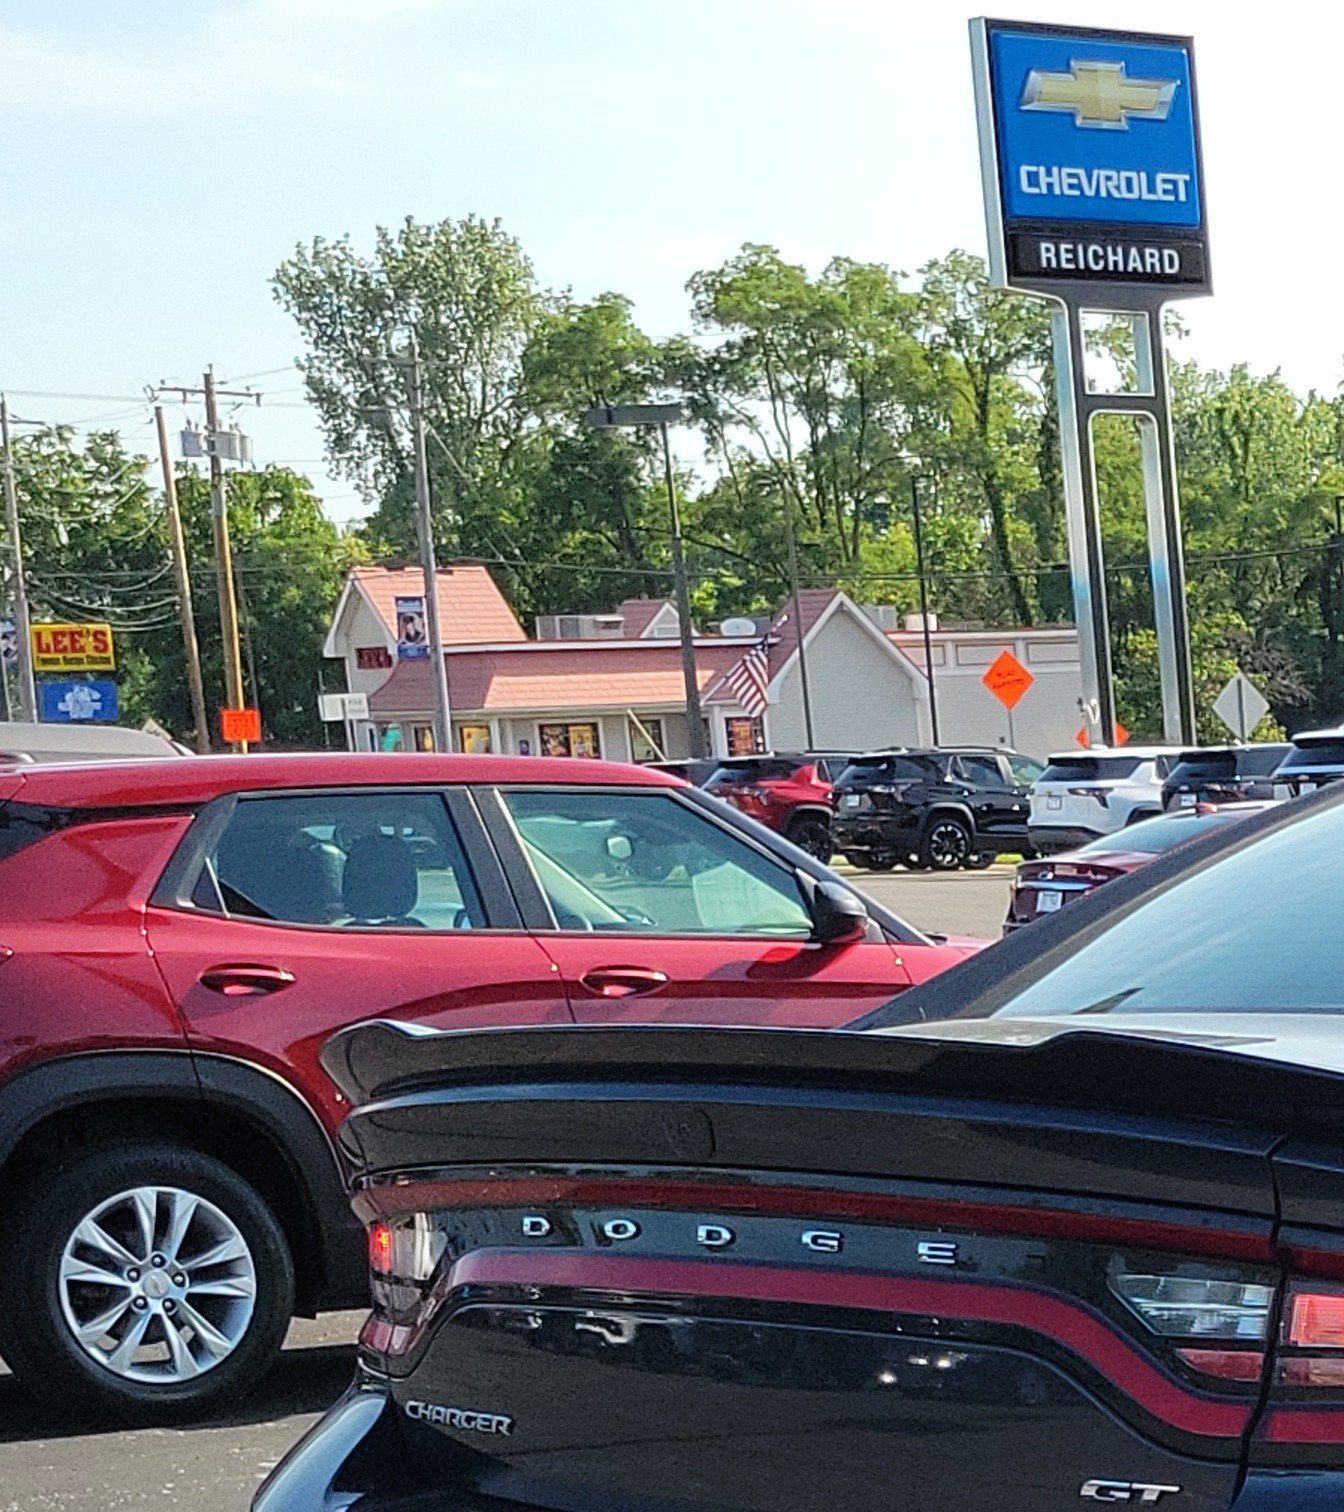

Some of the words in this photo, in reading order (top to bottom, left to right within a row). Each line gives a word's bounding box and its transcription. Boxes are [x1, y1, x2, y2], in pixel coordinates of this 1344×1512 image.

[1019, 164, 1190, 202] CHEVROLET
[1040, 242, 1180, 275] REICHARD
[34, 629, 109, 654] LEE'S
[521, 1216, 957, 1265] DODGE
[404, 1399, 513, 1437] CHARGER
[1080, 1478, 1181, 1503] GT
